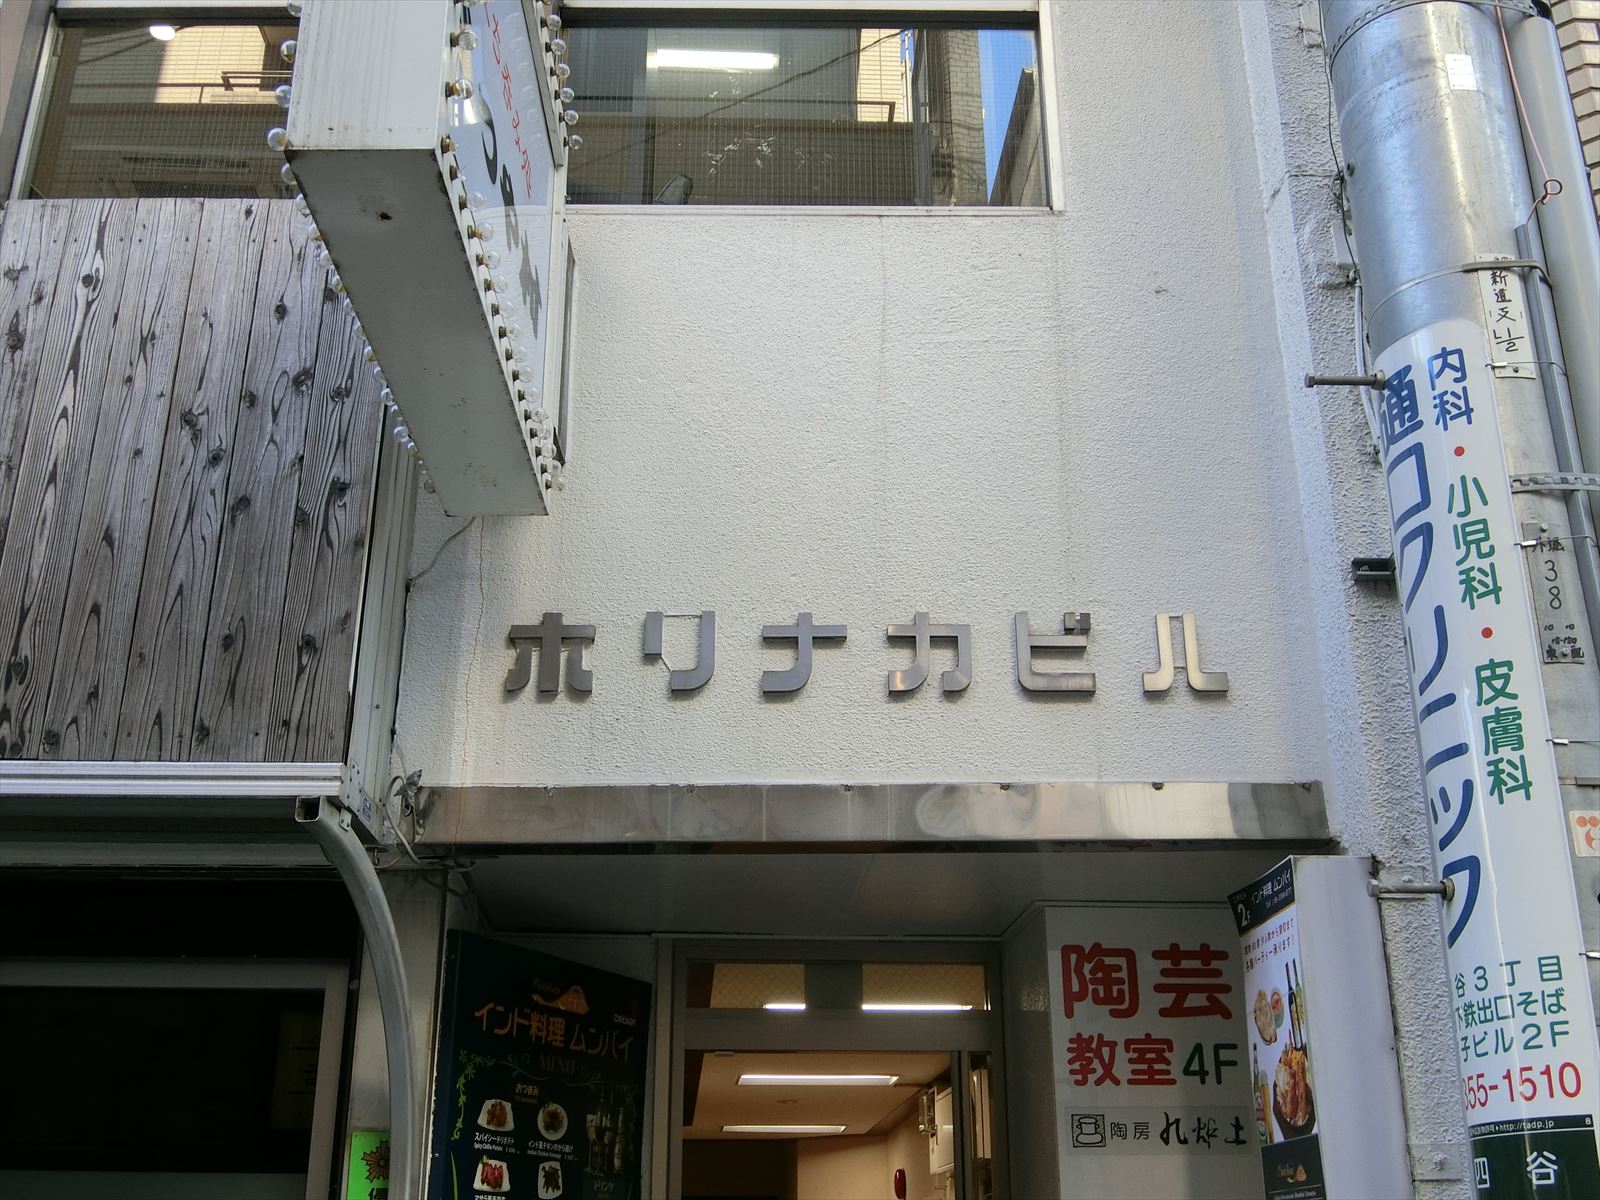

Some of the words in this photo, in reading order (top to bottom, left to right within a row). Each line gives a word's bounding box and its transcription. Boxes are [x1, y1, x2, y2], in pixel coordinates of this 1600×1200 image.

[505, 611, 1229, 695] ホリナカビル
[1060, 942, 1233, 1020] 陶芸
[473, 1001, 566, 1048] インド料理
[569, 1023, 635, 1062] ムンバイ
[1066, 1033, 1177, 1087] 教室
[1182, 1042, 1239, 1086] 4F
[1110, 1121, 1152, 1141] 陶房
[1474, 1151, 1559, 1189] 四谷
